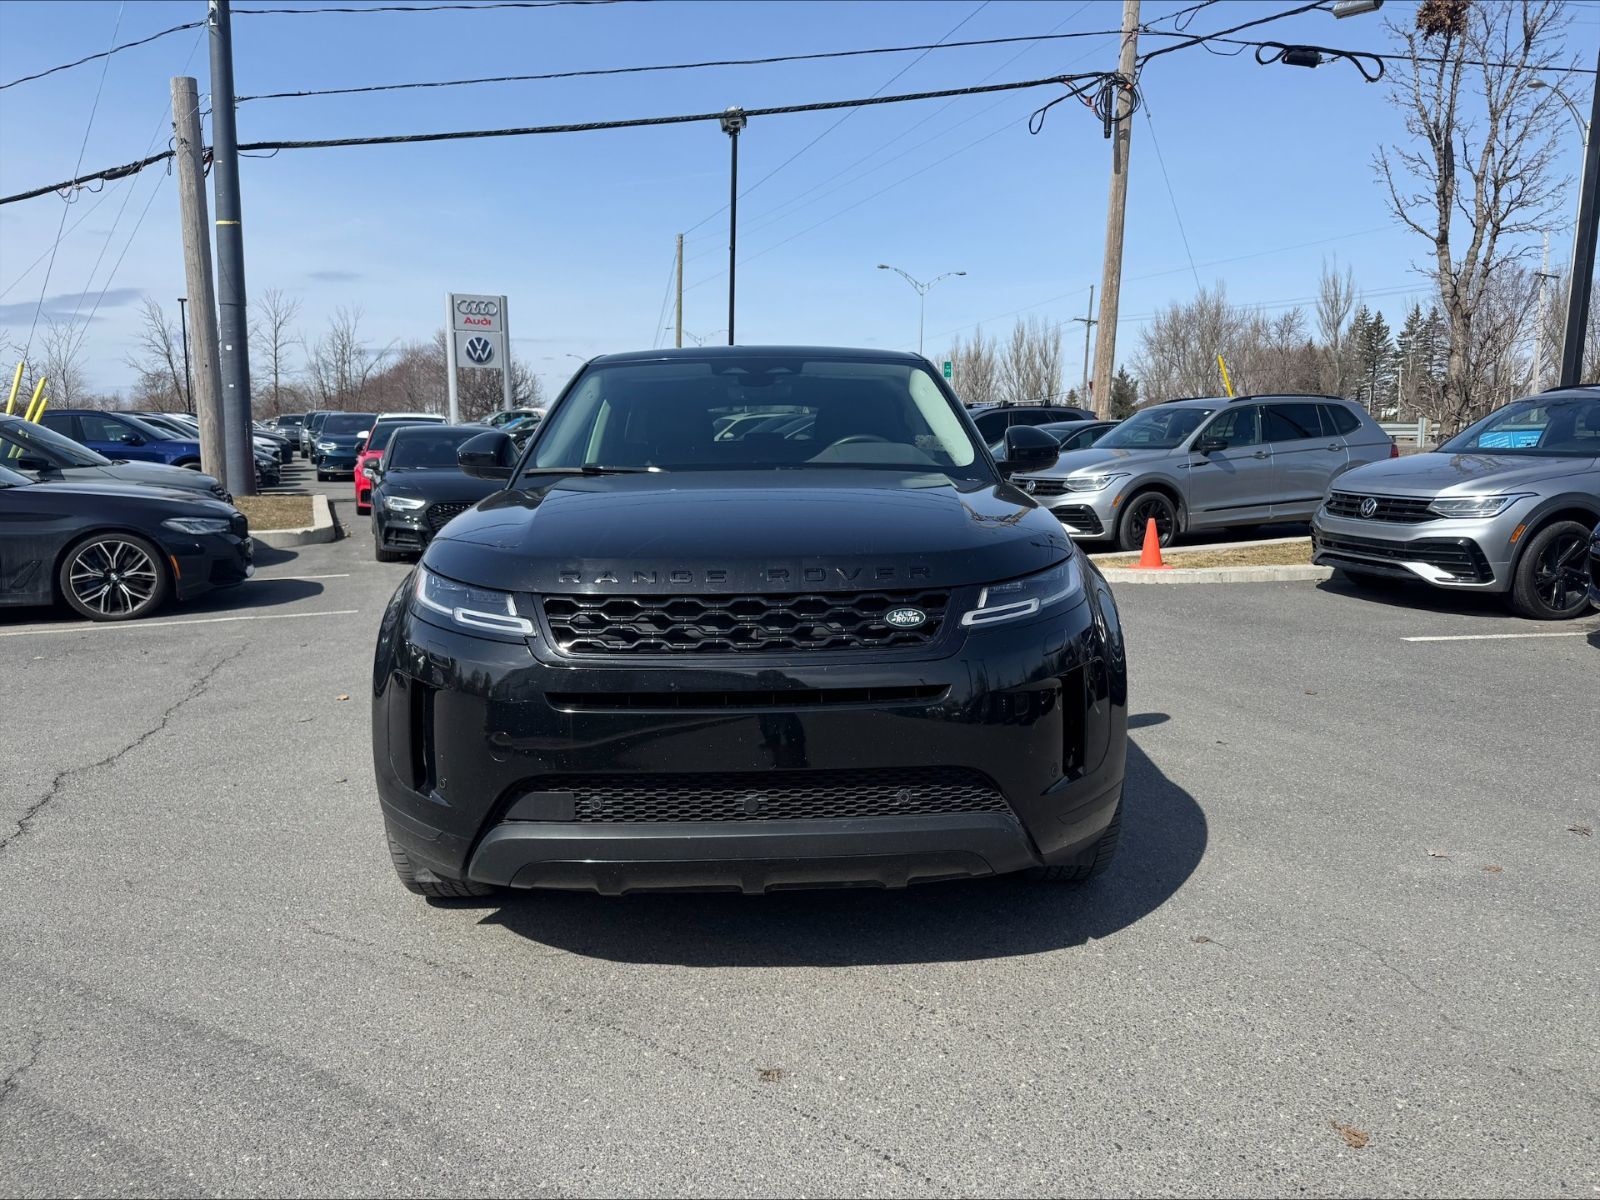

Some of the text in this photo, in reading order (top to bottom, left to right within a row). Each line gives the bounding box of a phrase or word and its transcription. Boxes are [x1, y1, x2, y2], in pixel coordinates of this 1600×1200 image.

[464, 317, 491, 326] Audi
[559, 567, 931, 584] RANGE ROVER
